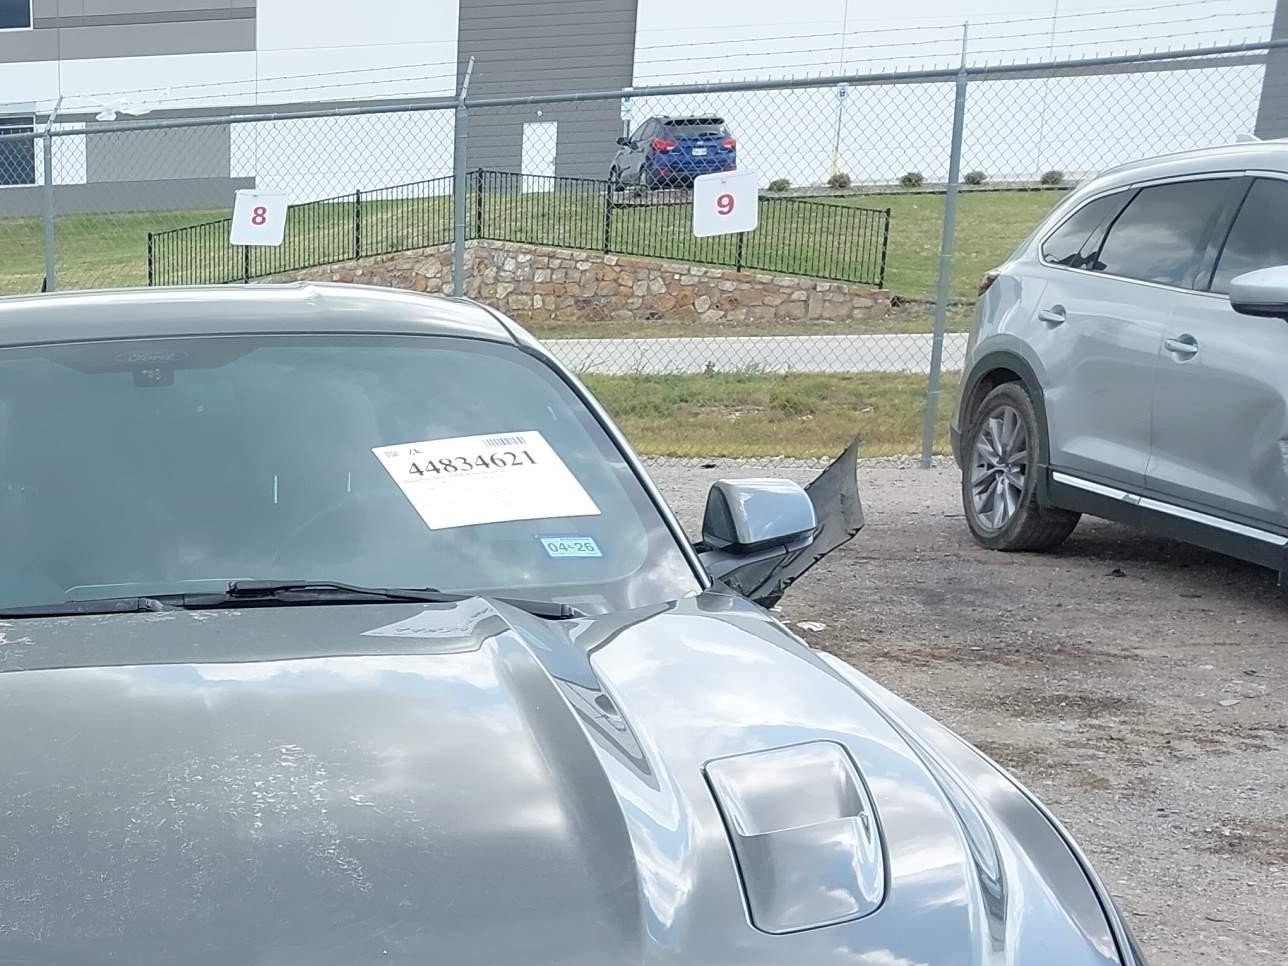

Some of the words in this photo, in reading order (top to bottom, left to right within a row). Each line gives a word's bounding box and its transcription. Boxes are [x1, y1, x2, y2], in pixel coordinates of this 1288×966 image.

[717, 194, 734, 215] 9
[252, 206, 267, 225] 8
[408, 450, 537, 476] 44834621
